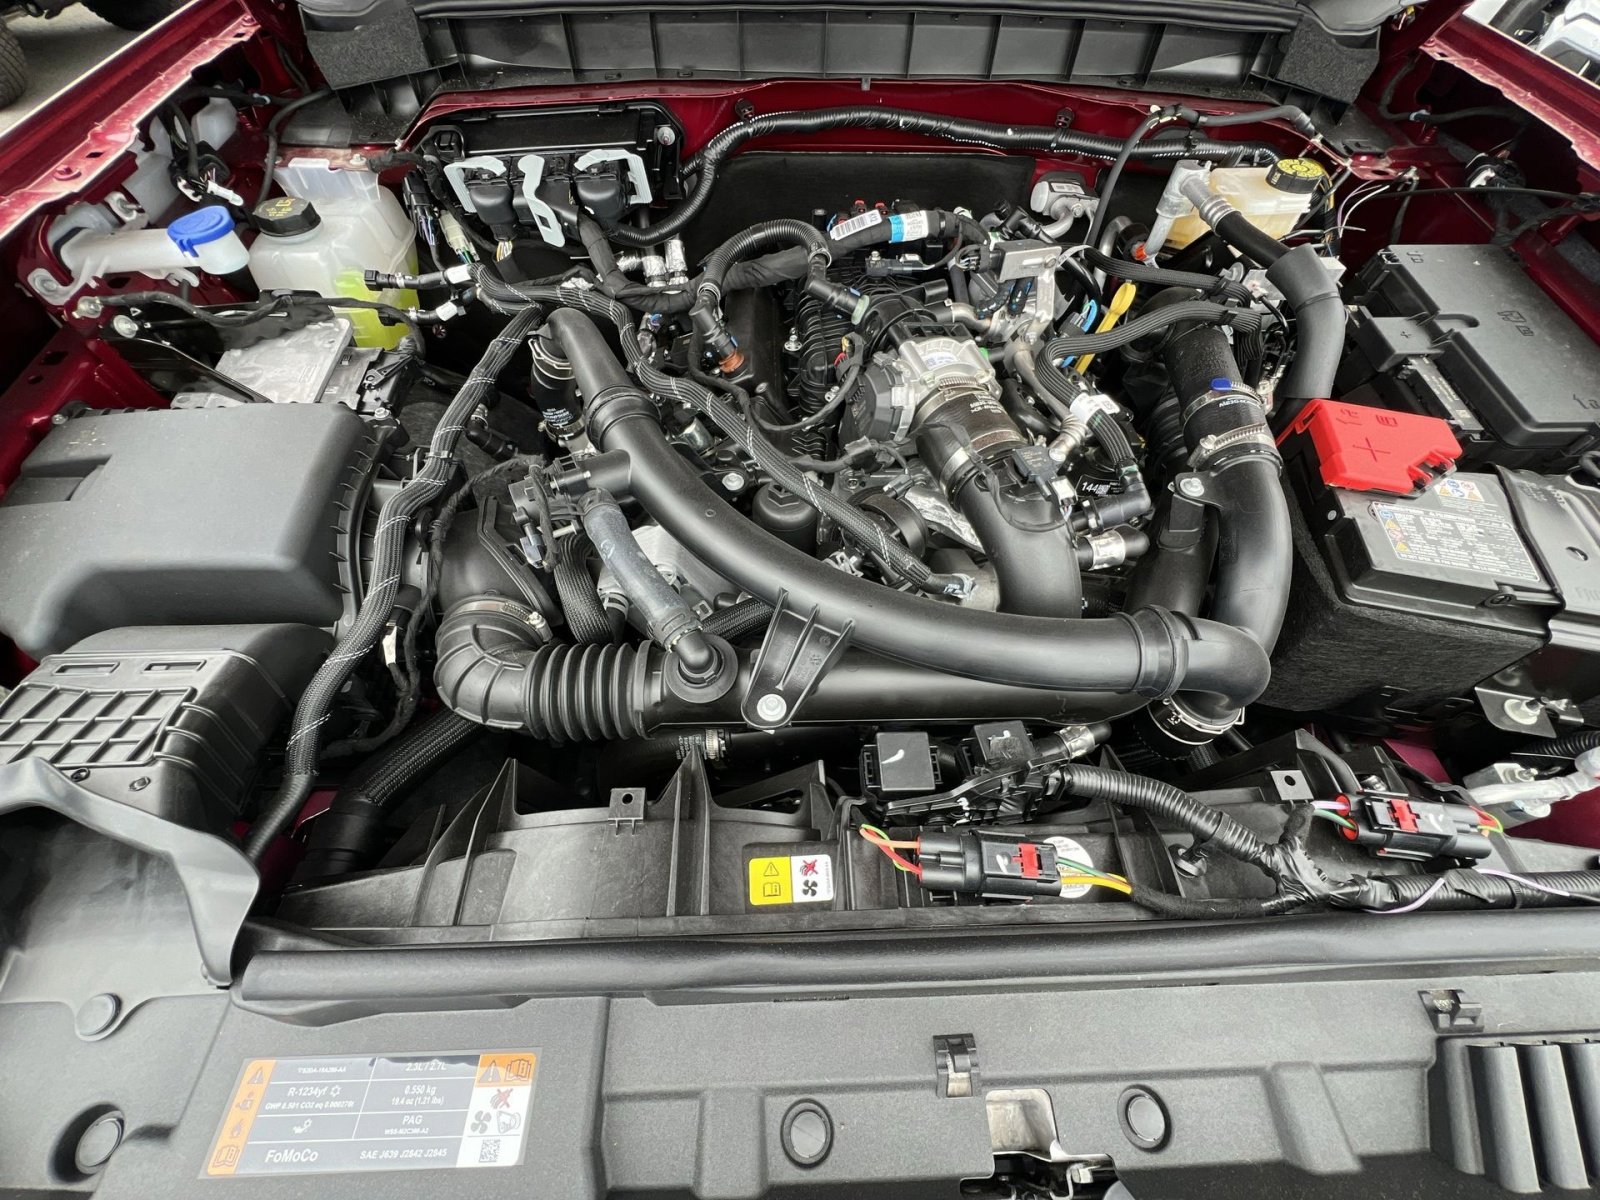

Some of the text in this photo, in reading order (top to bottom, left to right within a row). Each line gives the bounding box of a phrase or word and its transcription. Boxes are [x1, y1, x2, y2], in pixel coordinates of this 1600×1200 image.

[405, 1063, 423, 1072] 2.3L
[430, 1062, 446, 1070] 2.7L
[287, 1086, 328, 1098] R-1234yf
[404, 1084, 437, 1096] 0.550 kg
[392, 1096, 405, 1106] 19.4
[414, 1096, 430, 1106] (1.21
[402, 1115, 423, 1125] PAG
[264, 1148, 318, 1162] FoMoCo
[360, 1148, 448, 1159] SAE J639 J2842 J2845
